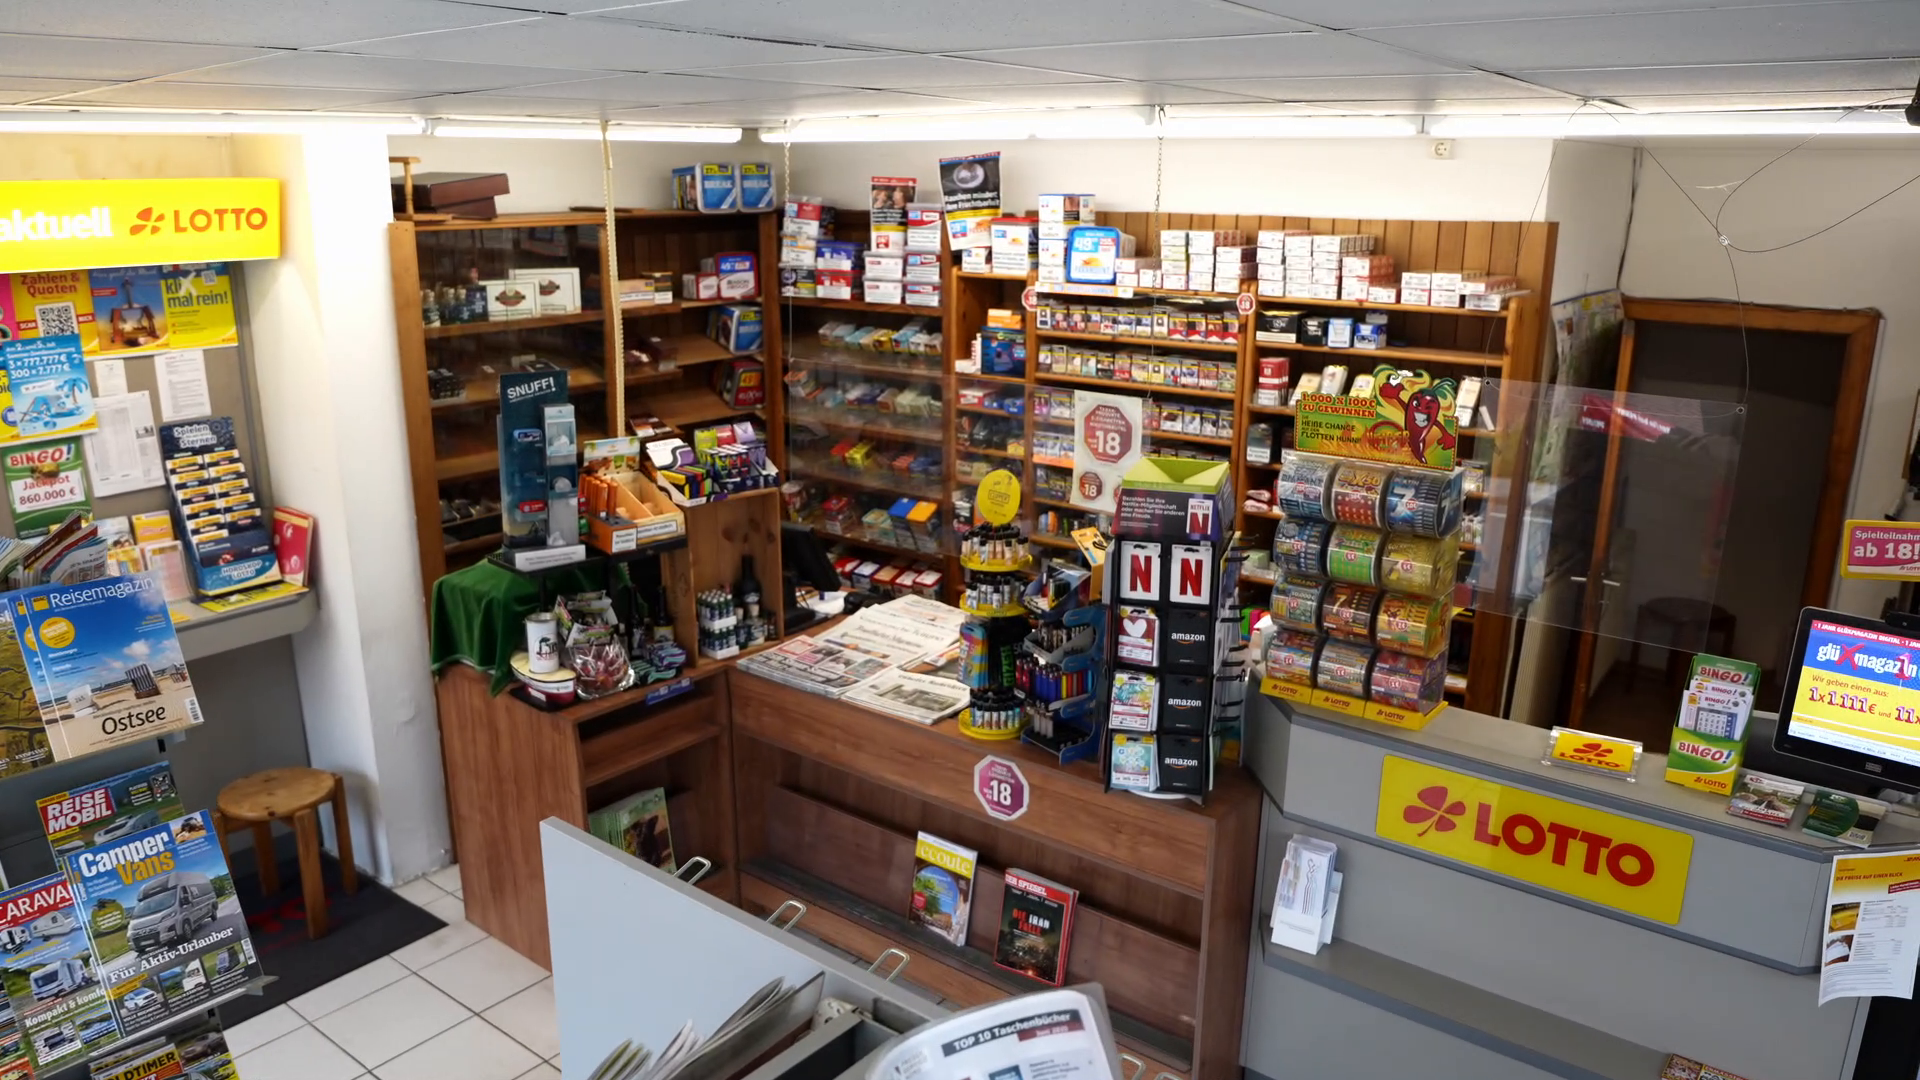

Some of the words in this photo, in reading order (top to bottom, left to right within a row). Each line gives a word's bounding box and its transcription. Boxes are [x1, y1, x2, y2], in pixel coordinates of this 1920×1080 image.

[0, 207, 114, 241] aktuell
[174, 208, 268, 233] LOTTO
[21, 274, 67, 285] Zahlen
[71, 273, 79, 281] &
[27, 285, 77, 298] Quoten
[167, 296, 195, 309] mal
[196, 291, 229, 307] rein!
[507, 377, 556, 399] SNUFF!
[1302, 403, 1315, 411] ZU
[1317, 404, 1375, 418] GEWINNEN
[174, 425, 209, 438] Spielen
[1324, 421, 1356, 432] CHANCE
[180, 436, 217, 448] Sternen
[1096, 430, 1120, 456] 18
[1301, 431, 1335, 441] FLOTTEN
[9, 444, 74, 467] BINGO!
[23, 475, 71, 491] Jackpot
[1085, 484, 1097, 497] 18
[19, 489, 66, 506] 860.000
[69, 487, 76, 496] €
[1190, 504, 1210, 512] NETFLIX
[1854, 542, 1878, 558] ab
[1884, 542, 1920, 560] 18!
[1130, 554, 1153, 593] N
[1179, 558, 1203, 597] N
[50, 577, 155, 608] Reisemagazin
[1171, 632, 1205, 642] amazon
[1700, 666, 1753, 685] BINGO!
[1279, 686, 1298, 695] LOTTO
[1812, 674, 1825, 683] Wir
[1826, 678, 1849, 689] geben
[1850, 684, 1871, 693] einen
[1873, 688, 1889, 698] aus:
[1168, 698, 1201, 707] amazon
[1331, 698, 1351, 708] LOTTO
[101, 706, 166, 735] Ostsee
[1385, 710, 1405, 720] LOTTO
[1878, 710, 1891, 719] und
[1164, 756, 1198, 767] amazon
[1559, 752, 1621, 768] LOTTO
[1678, 742, 1735, 764] BINGO!
[1703, 778, 1728, 789] LOTTO
[990, 780, 1012, 806] 18
[47, 788, 107, 820] REISE
[48, 803, 112, 834] MOBIL
[1473, 801, 1655, 887] LOTTO
[78, 831, 169, 877] Camper
[116, 852, 176, 886] Vans
[1028, 914, 1050, 929] IRAN
[108, 966, 137, 984] Für
[140, 927, 234, 971] Aktiv-Urlauber
[25, 1003, 67, 1028] Kompakt
[953, 1036, 976, 1052] TOP
[977, 1032, 992, 1044] 10
[994, 1013, 1071, 1039] Taschenbücher
